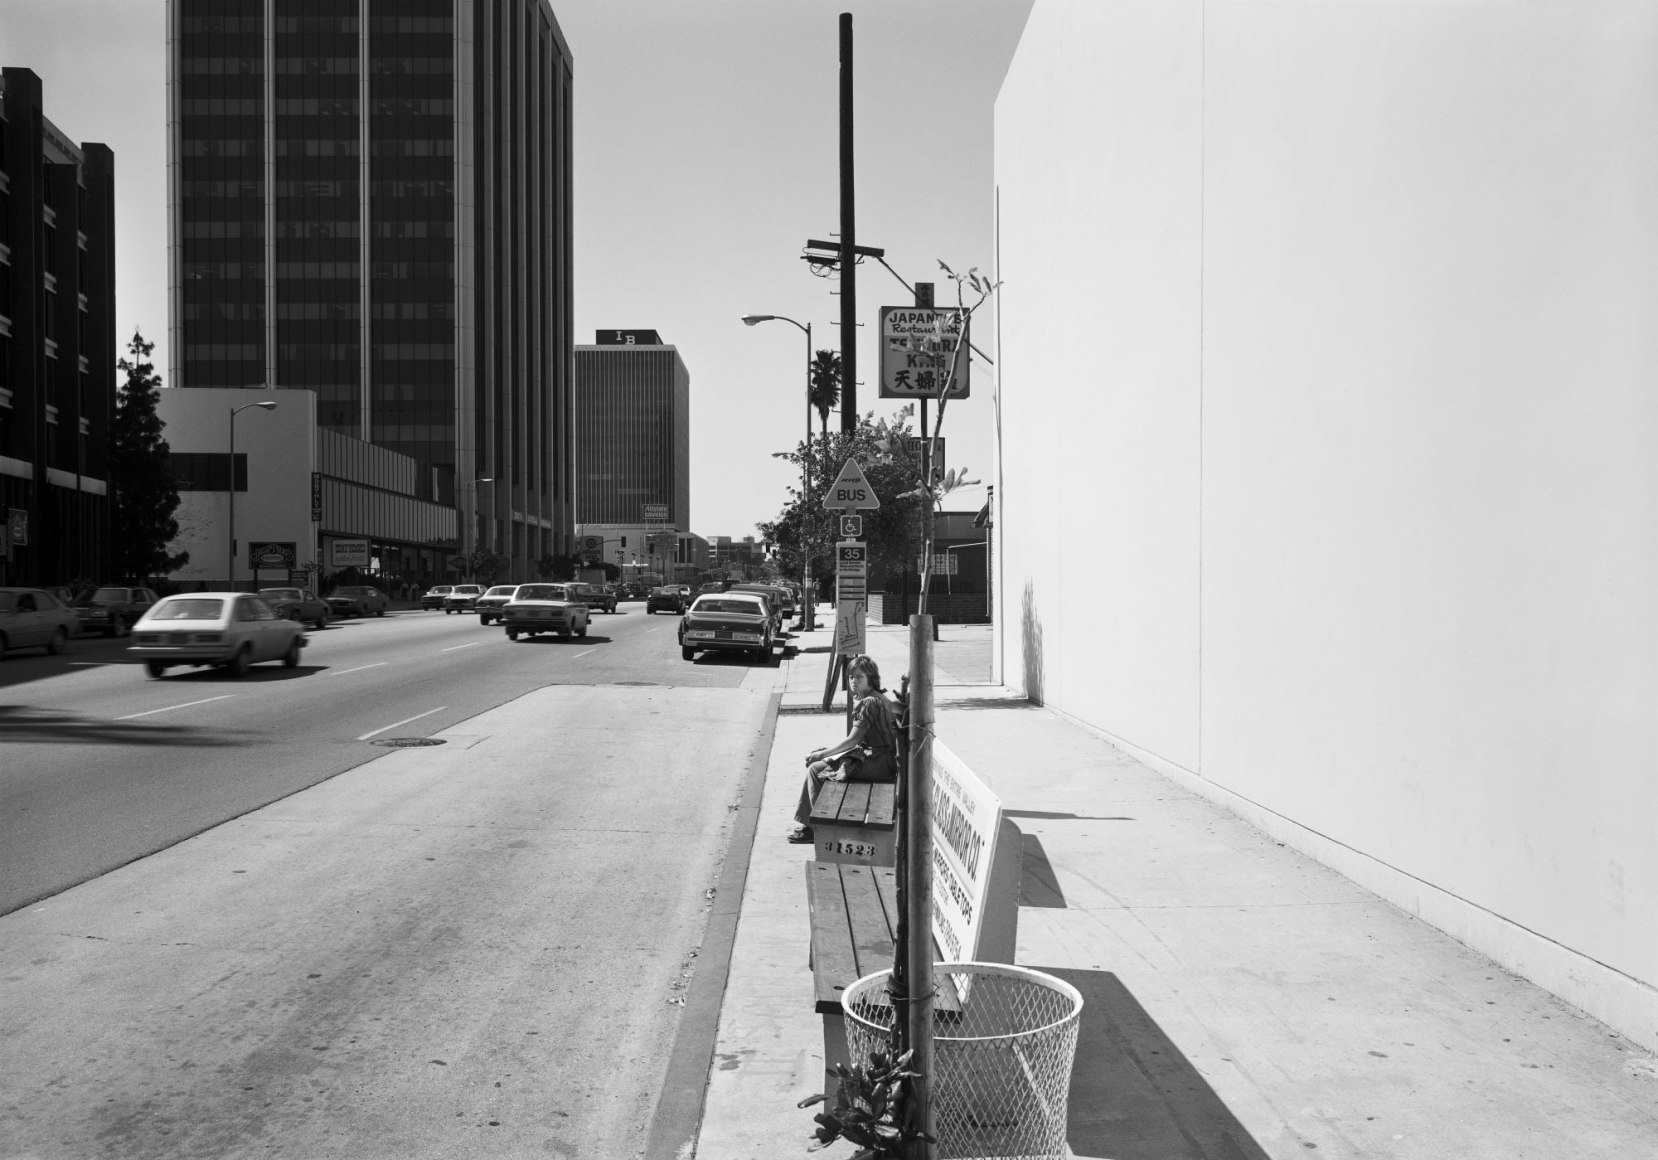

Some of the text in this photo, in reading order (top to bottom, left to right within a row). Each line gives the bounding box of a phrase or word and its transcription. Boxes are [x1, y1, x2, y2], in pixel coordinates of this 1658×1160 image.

[889, 312, 963, 324] JAPANE
[892, 323, 960, 334] Restaurnt
[889, 338, 962, 352] TEURA
[837, 489, 866, 501] BUS
[844, 548, 860, 559] 35
[825, 841, 875, 856] 31523
